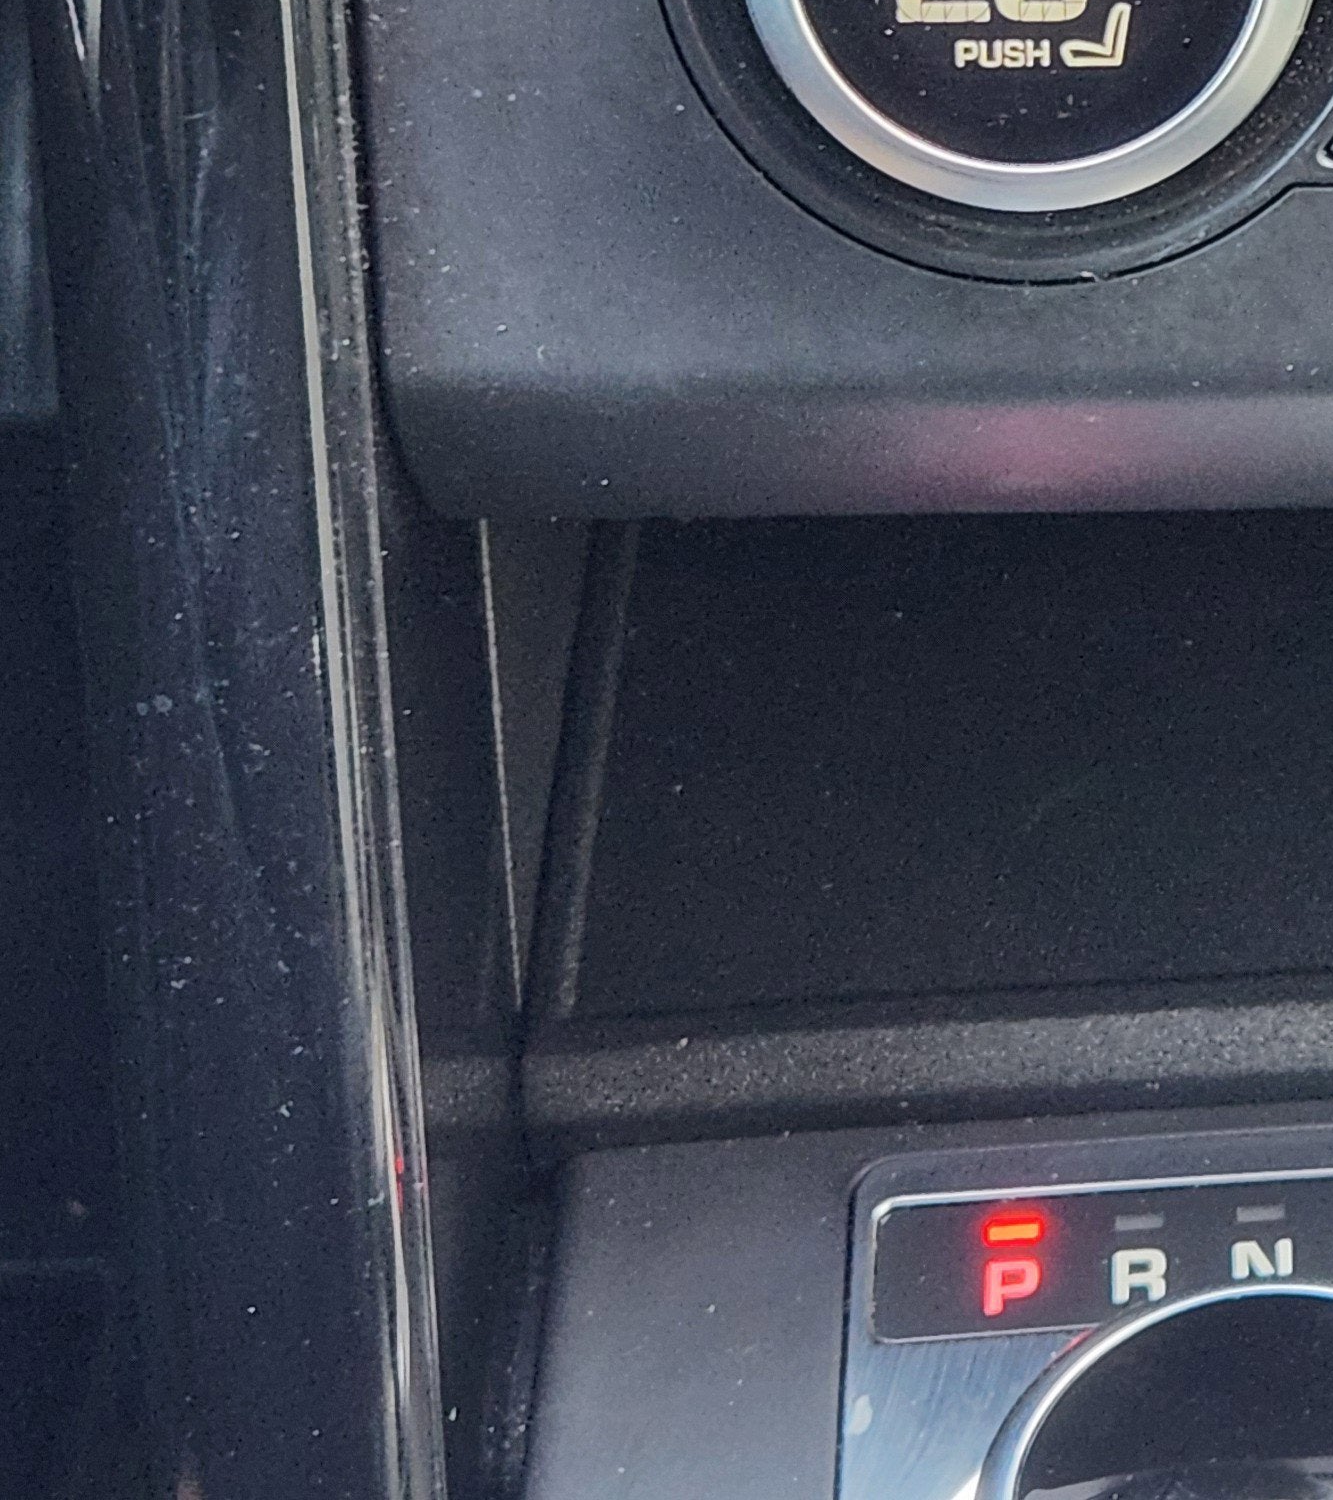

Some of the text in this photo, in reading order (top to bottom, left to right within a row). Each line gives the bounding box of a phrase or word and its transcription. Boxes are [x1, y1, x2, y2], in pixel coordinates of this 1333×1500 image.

[954, 38, 1051, 68] PUSH
[983, 1257, 1042, 1316] P
[1111, 1248, 1167, 1305] R
[1231, 1238, 1293, 1278] N
